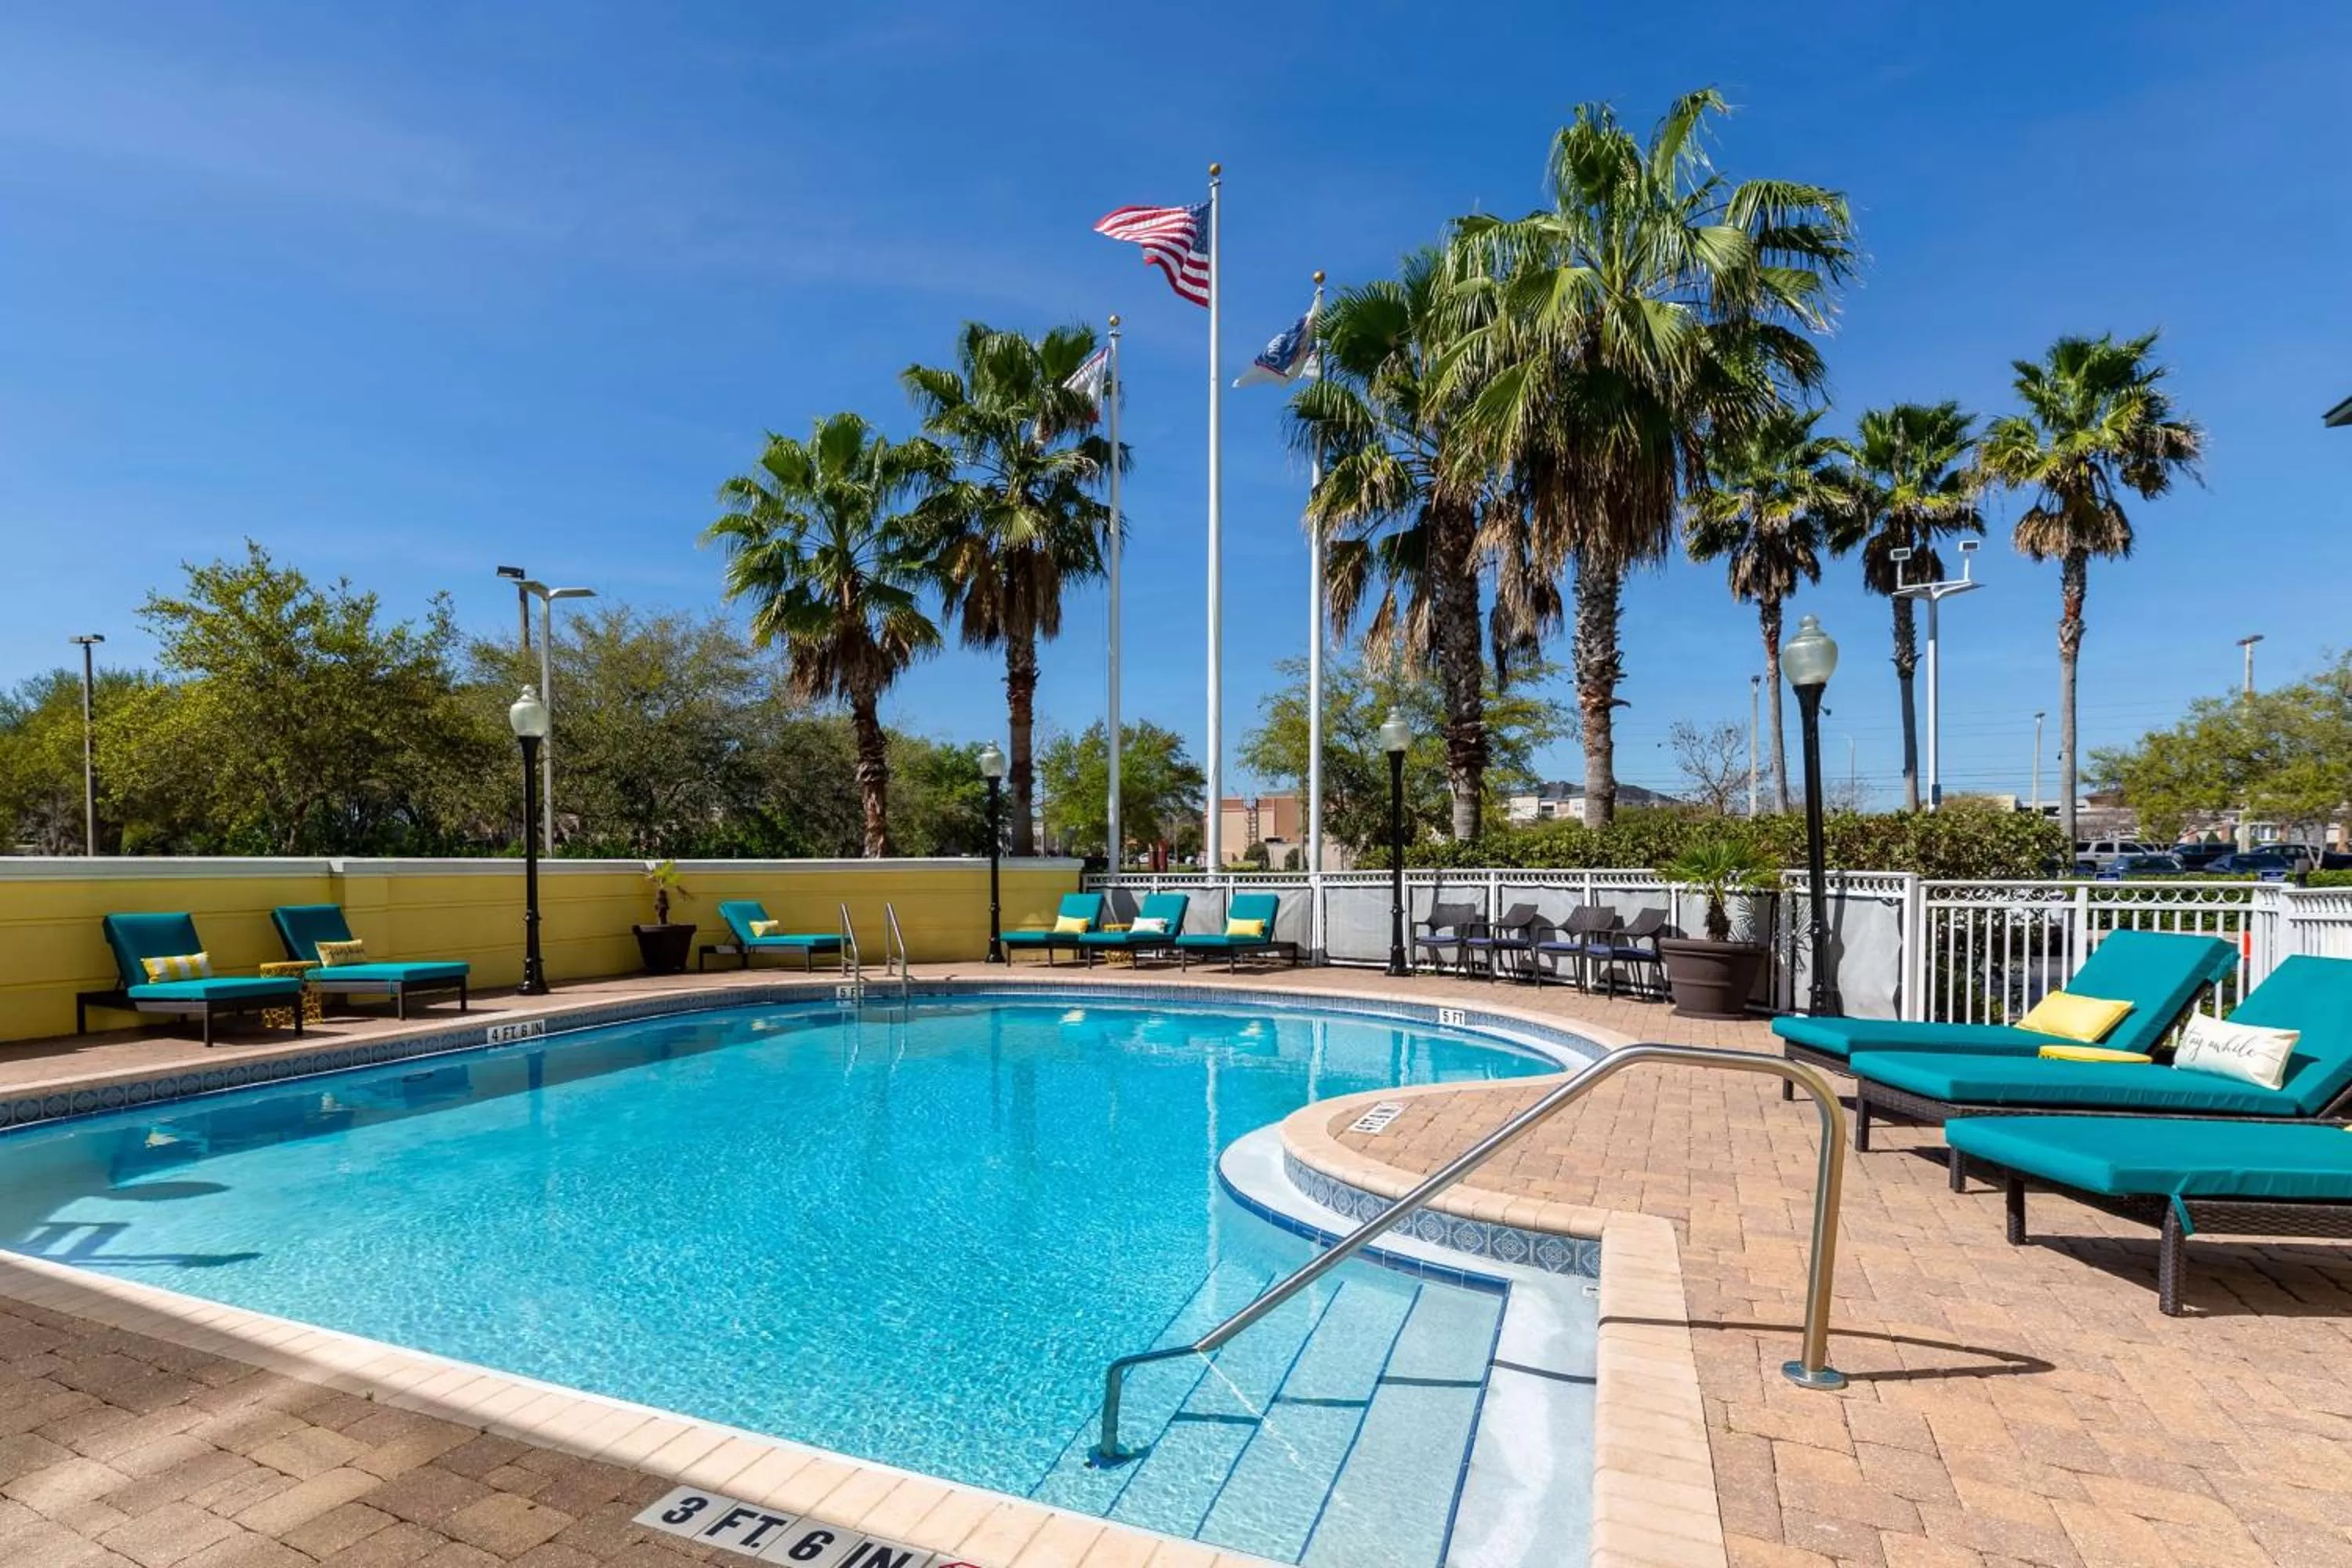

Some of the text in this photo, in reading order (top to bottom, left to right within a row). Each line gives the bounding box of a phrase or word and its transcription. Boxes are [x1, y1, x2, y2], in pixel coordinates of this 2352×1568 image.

[1443, 1011, 1450, 1022] 5
[492, 1028, 499, 1042] 4
[531, 1021, 543, 1035] IN
[661, 1496, 709, 1526] 3
[704, 1508, 787, 1548] FT.
[787, 1529, 835, 1562] 6
